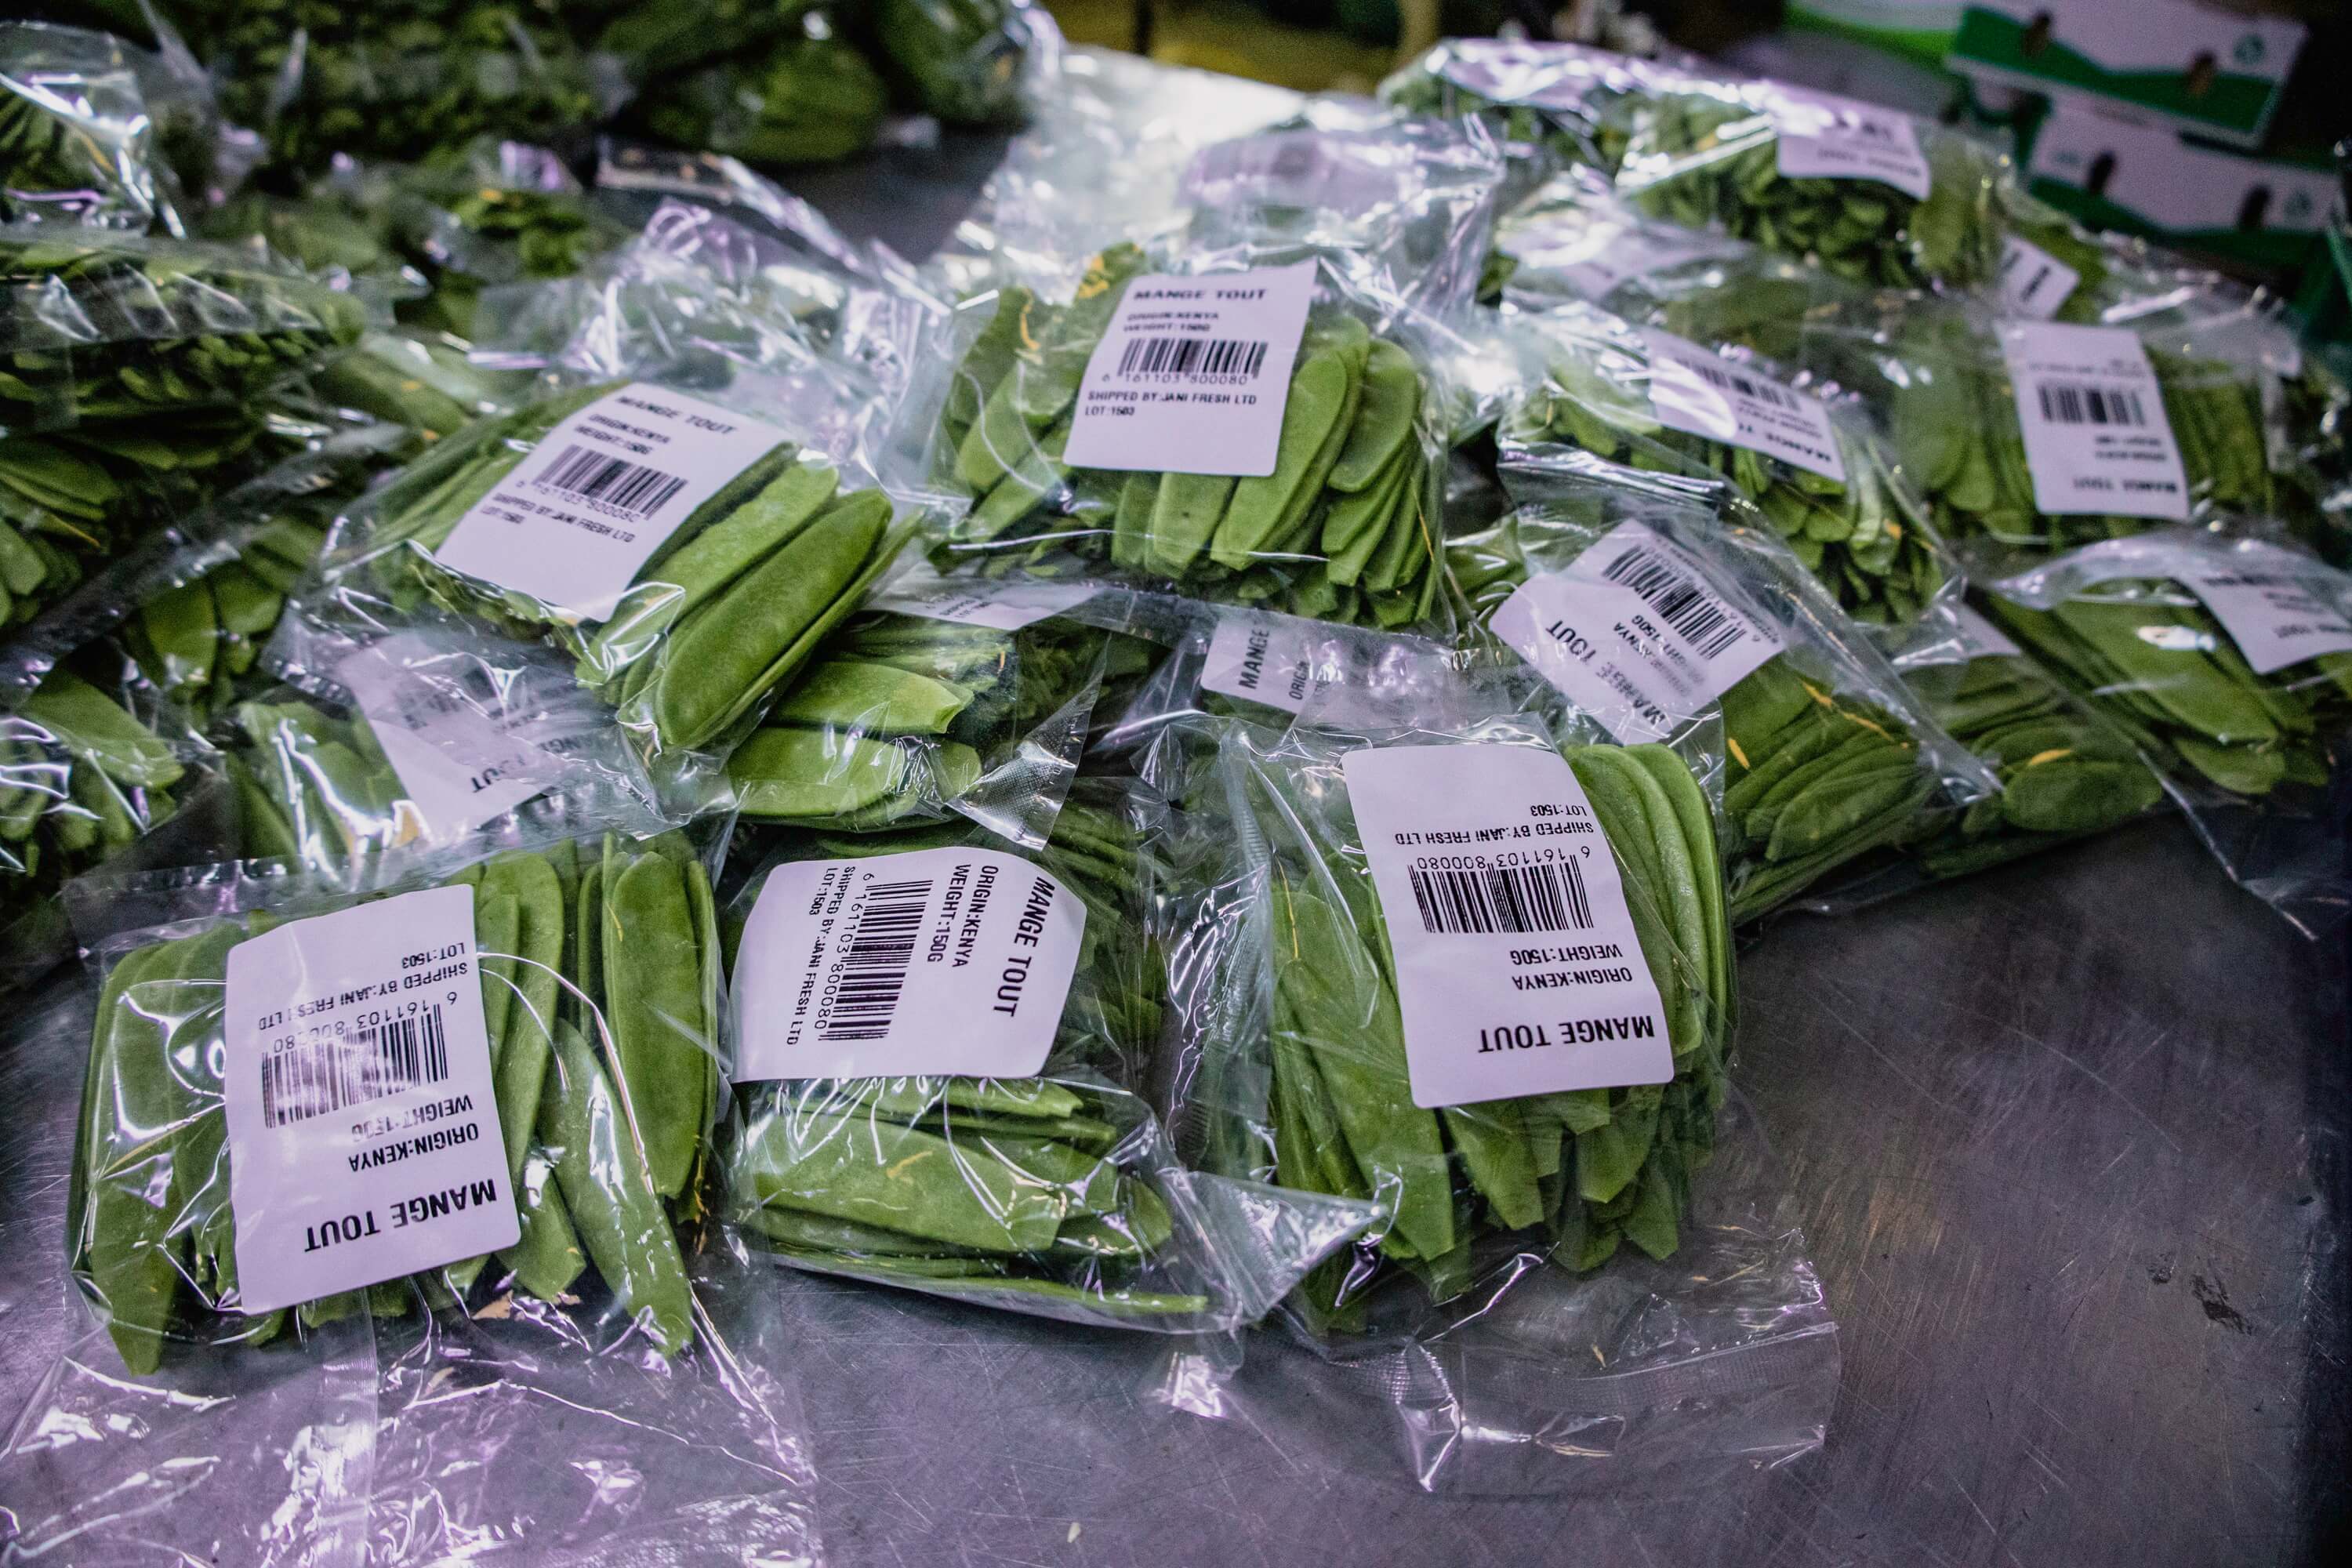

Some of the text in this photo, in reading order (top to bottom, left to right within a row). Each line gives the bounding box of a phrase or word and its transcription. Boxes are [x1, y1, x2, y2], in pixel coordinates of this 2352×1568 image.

[1134, 289, 1267, 300] MANGE TOUT
[1087, 391, 1138, 402] SHIPPED
[1192, 394, 1230, 405] FRESH
[1235, 395, 1258, 405] LTD
[685, 413, 737, 435] TOUT
[1238, 629, 1269, 690] MANGE
[1530, 804, 1587, 817] LOT:1503
[1396, 833, 1421, 845] LTD
[1426, 830, 1471, 844] FRESH
[1535, 822, 1594, 837] SHIPPED
[1417, 845, 1591, 869] 6 161103 800080
[809, 866, 838, 916] LOT:1503
[826, 866, 856, 915] SHIPPED
[927, 863, 971, 964] WEIGHT:150G
[952, 865, 1000, 968] ORIGIN:KENYA
[401, 942, 465, 969] LOT:1503
[815, 873, 875, 1030] 6 161103 800080
[993, 876, 1055, 1018] MANGE TOUT
[1510, 944, 1623, 966] WEIGHT:150G
[404, 962, 468, 989] SHIPPED
[1512, 967, 1633, 990] ORIGIN:KENYA
[795, 971, 816, 1017] FRESH
[258, 1011, 283, 1031] LTD
[274, 991, 457, 1054] 6 161103 80080
[786, 1020, 804, 1047] LTD
[1478, 1015, 1655, 1054] MANGE TOUT
[349, 1123, 479, 1172] ORIGIN:KENYA
[304, 1179, 497, 1253] MANGE TOUT
